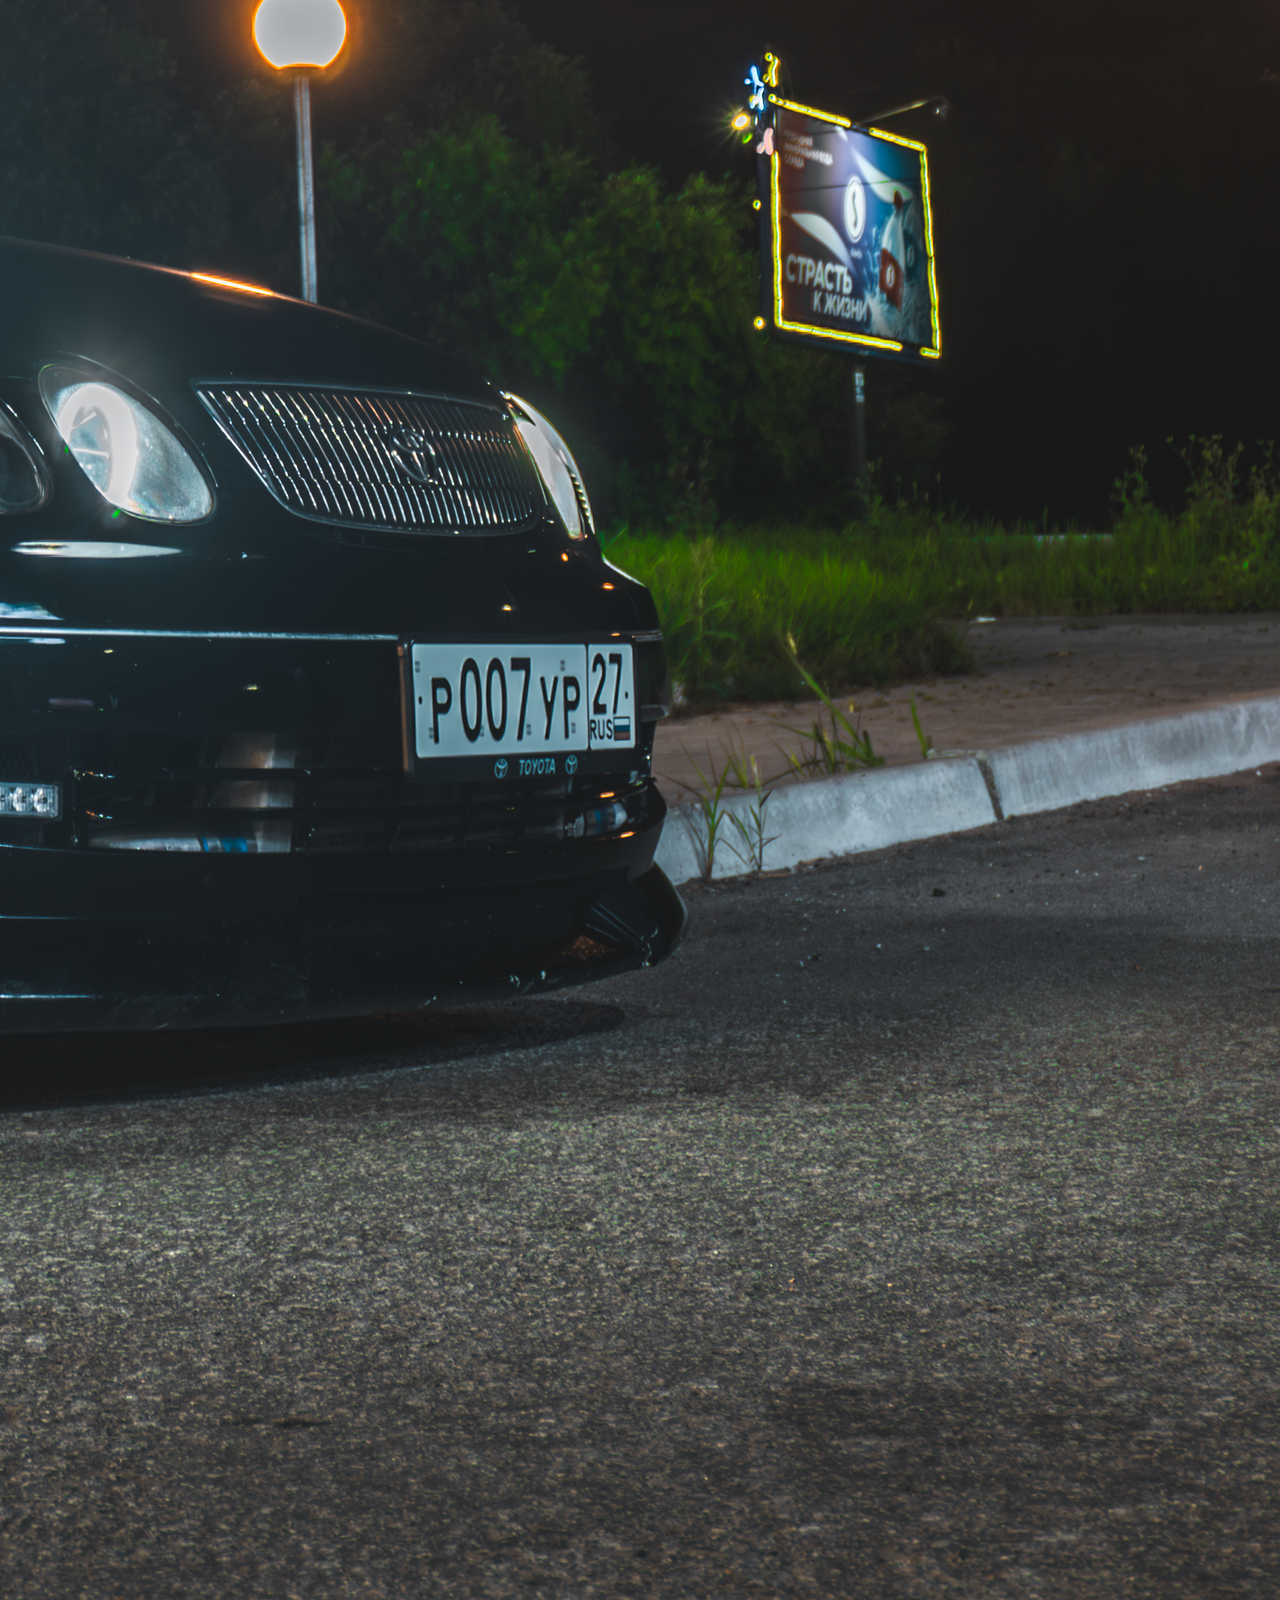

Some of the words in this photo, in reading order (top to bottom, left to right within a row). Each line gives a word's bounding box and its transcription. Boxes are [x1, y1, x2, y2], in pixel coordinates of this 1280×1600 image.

[786, 253, 852, 295] СТРАСТЬ
[813, 289, 822, 312] К
[823, 292, 868, 322] ЖИЗНИ
[592, 653, 622, 715] 27
[590, 719, 613, 740] RUS
[519, 758, 556, 775] TOYOTA
